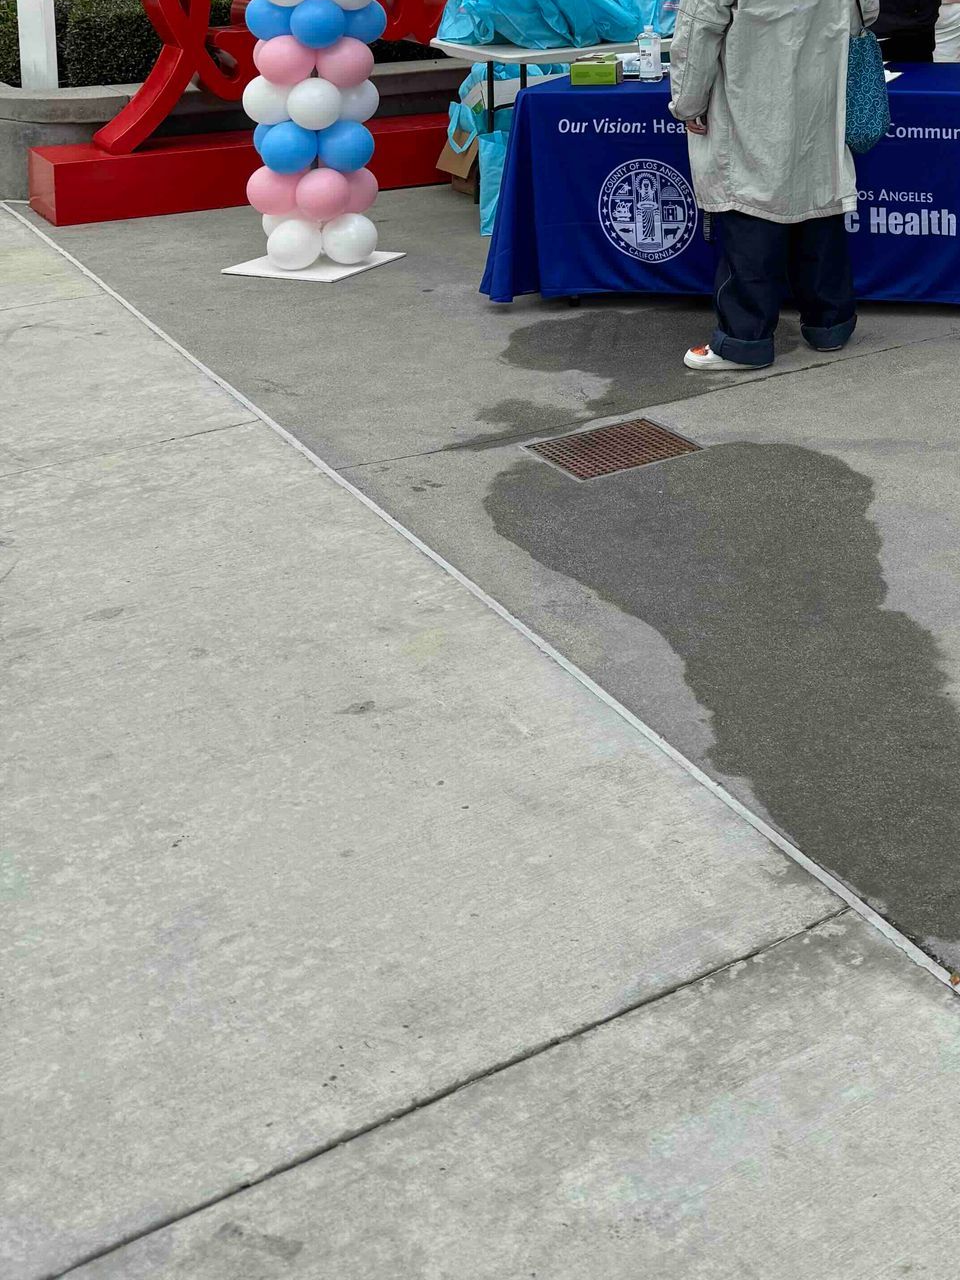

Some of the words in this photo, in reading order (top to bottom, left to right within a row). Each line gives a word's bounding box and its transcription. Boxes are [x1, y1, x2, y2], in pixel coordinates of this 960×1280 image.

[558, 118, 588, 134] Our
[593, 118, 647, 134] Vision:
[653, 119, 688, 134] Hea
[604, 166, 628, 194] COUNTY
[629, 162, 640, 171] OF
[642, 162, 658, 170] LOS
[660, 166, 690, 195] ANGELES
[857, 190, 874, 201] OS
[878, 188, 934, 203] ANGELES
[869, 206, 957, 237] Health
[628, 247, 675, 260] CALIFORNIA
